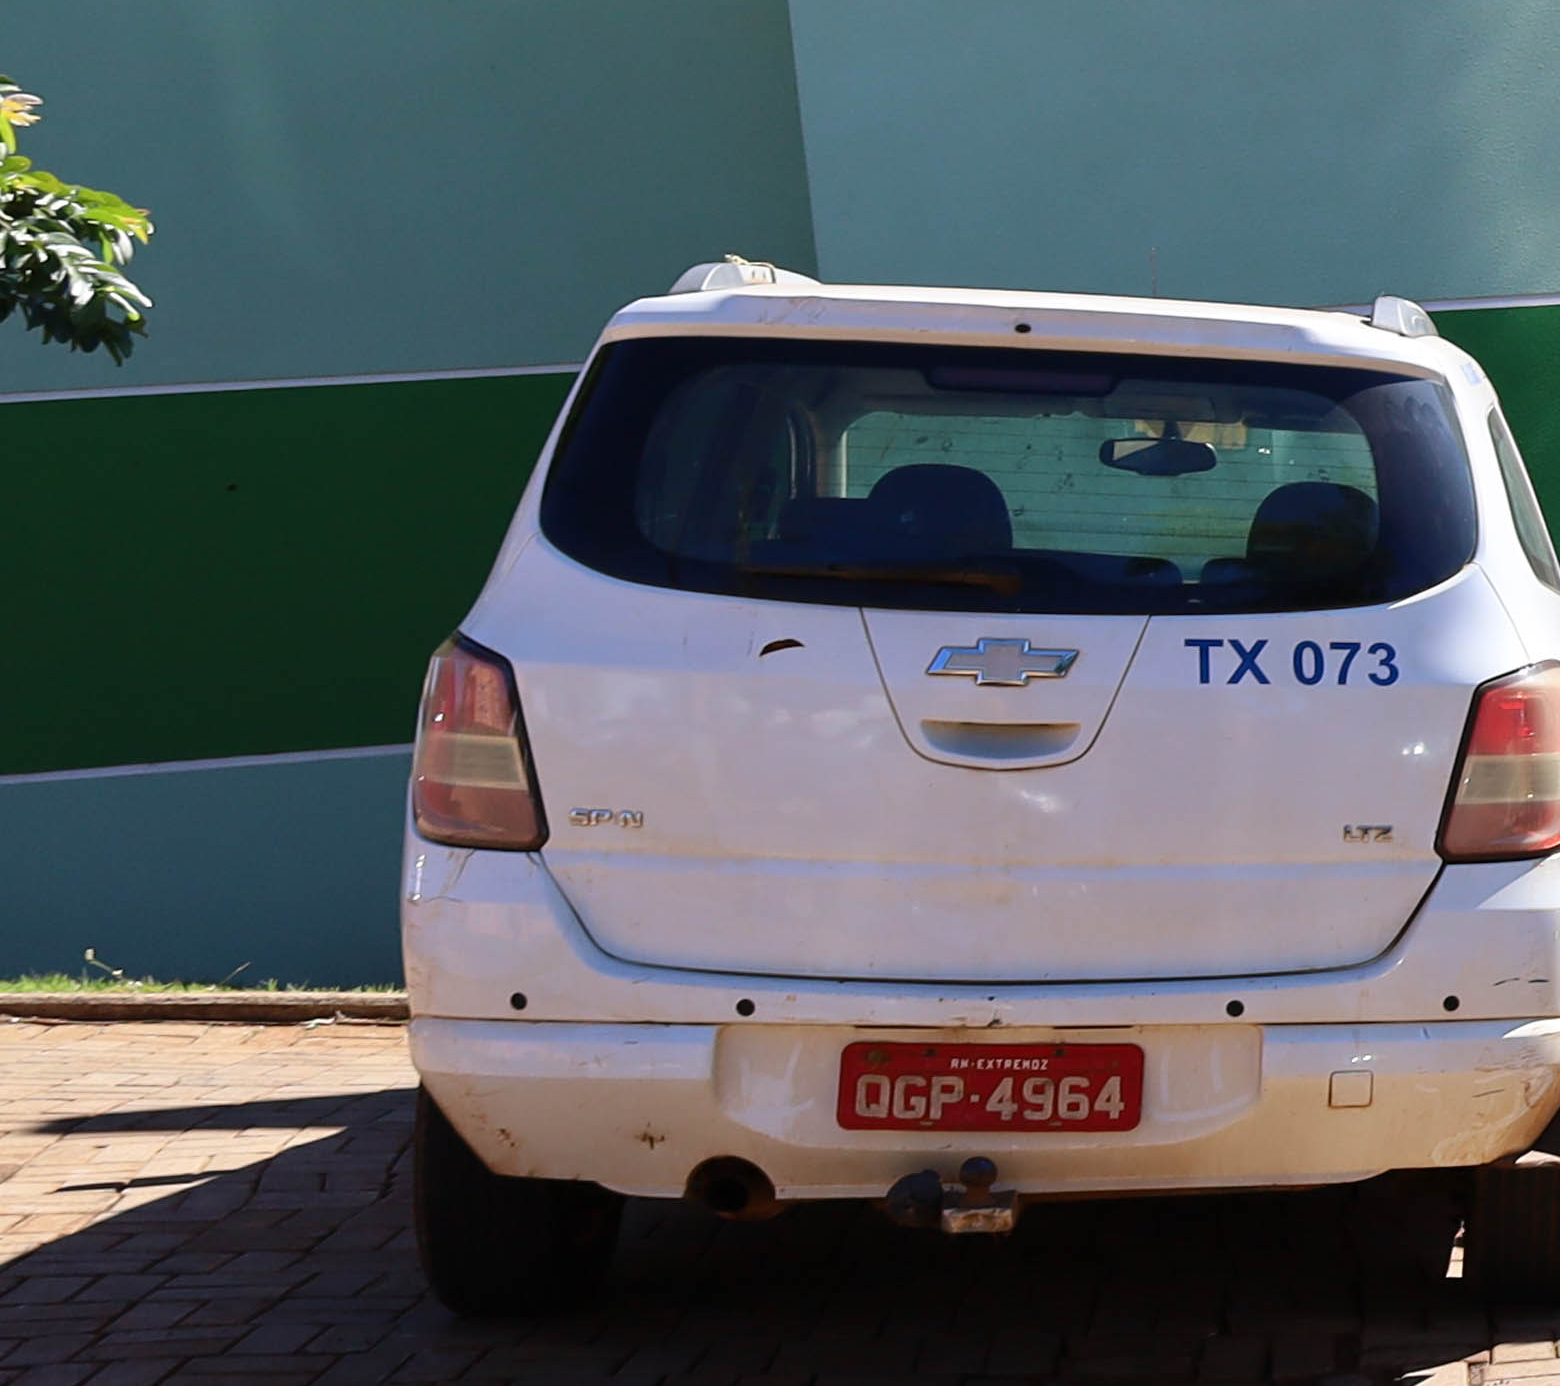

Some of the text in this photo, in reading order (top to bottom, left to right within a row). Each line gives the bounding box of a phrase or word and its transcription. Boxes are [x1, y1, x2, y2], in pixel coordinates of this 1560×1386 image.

[1183, 638, 1400, 687] TX 073
[1343, 824, 1393, 844] LTZ
